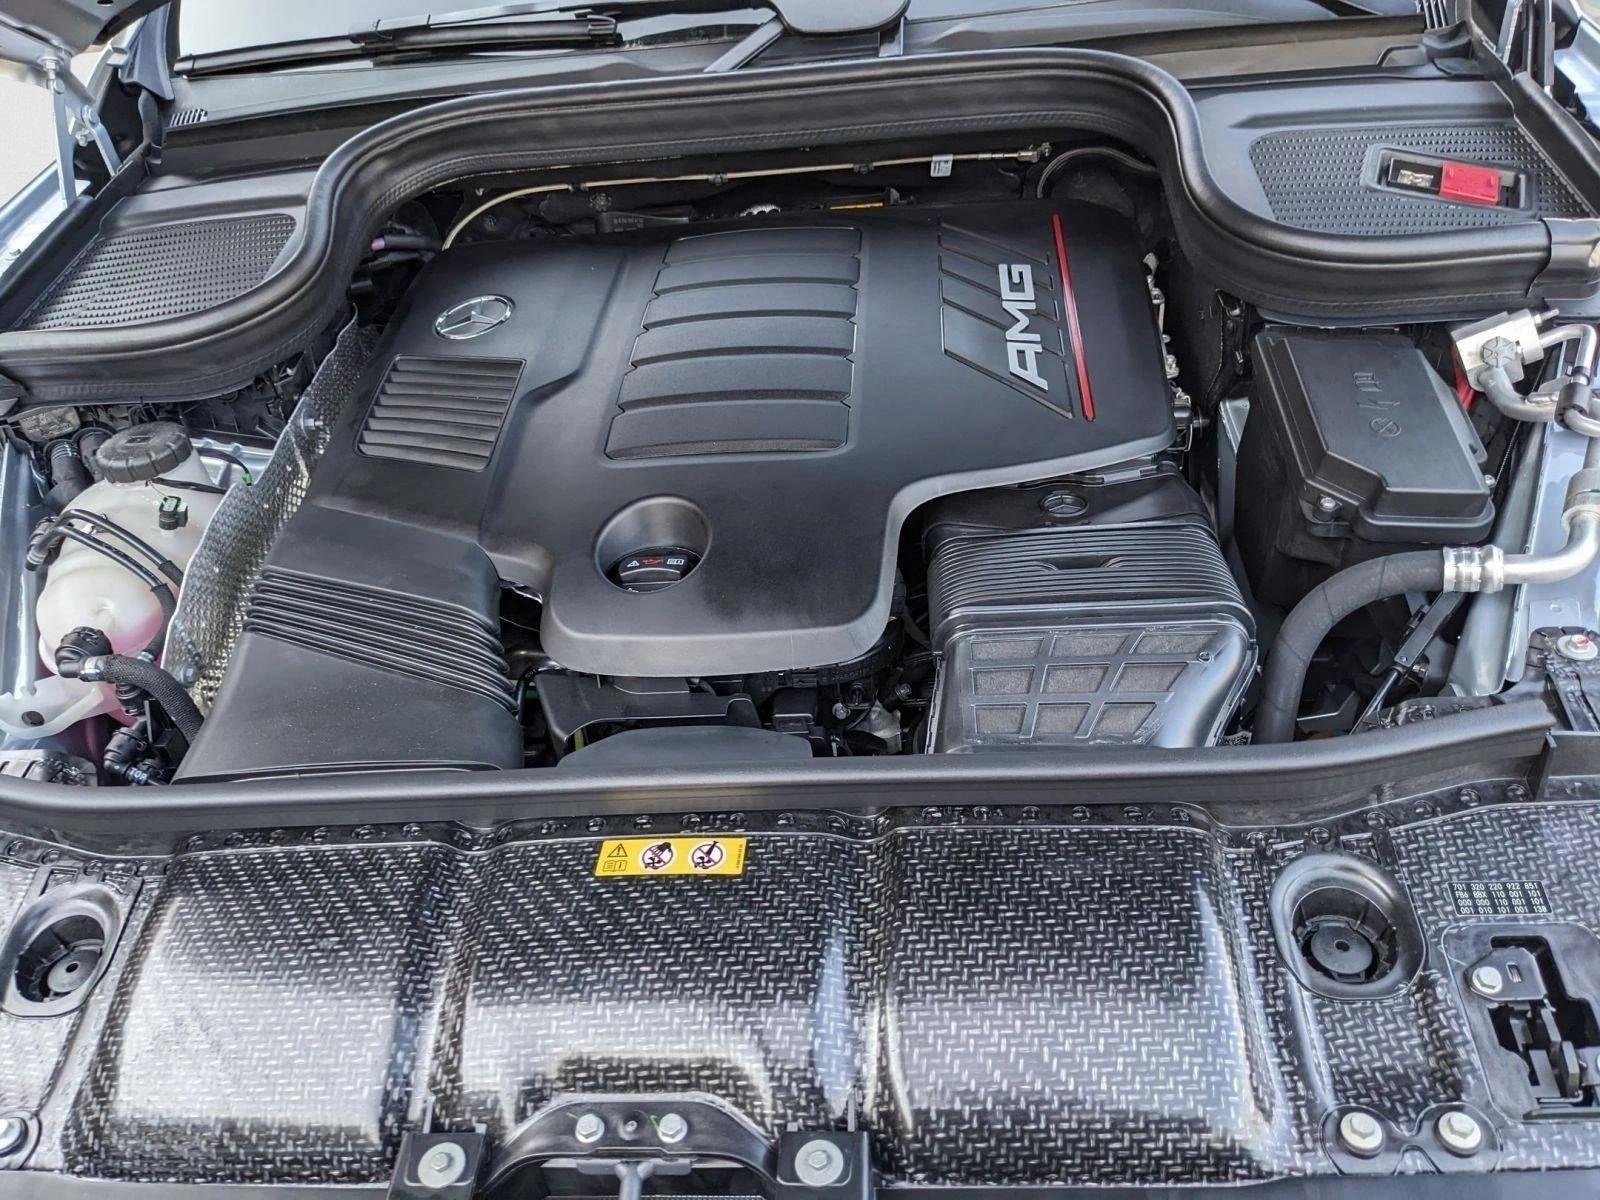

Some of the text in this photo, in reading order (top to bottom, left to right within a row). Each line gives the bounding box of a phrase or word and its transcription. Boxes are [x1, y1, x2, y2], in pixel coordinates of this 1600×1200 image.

[998, 263, 1049, 391] AMG
[1452, 883, 1467, 891] 701
[1470, 883, 1485, 891] 320
[1488, 883, 1503, 891] 220
[1491, 890, 1506, 898] 110
[1508, 890, 1523, 898] 001
[1457, 897, 1544, 906] 000 000 110 001 101
[1460, 906, 1475, 914] 001
[1478, 906, 1493, 914] 010
[1496, 906, 1511, 914] 101
[1514, 905, 1529, 913] 001
